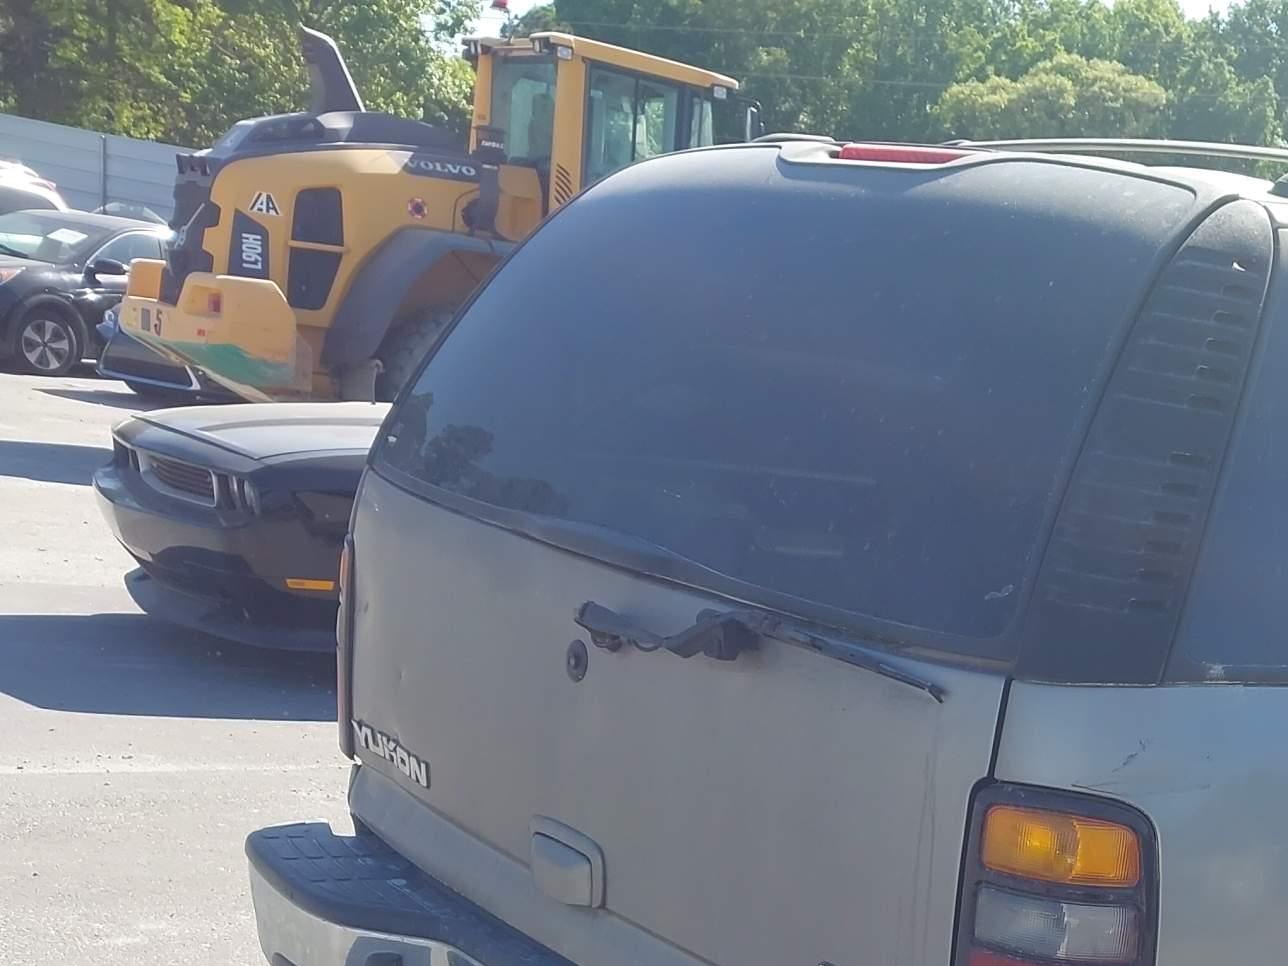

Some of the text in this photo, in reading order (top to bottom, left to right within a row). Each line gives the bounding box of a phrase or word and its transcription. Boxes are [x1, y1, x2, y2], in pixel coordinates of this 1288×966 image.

[407, 160, 476, 176] VOLVO
[241, 232, 262, 270] L90H
[351, 719, 429, 788] YUKON
